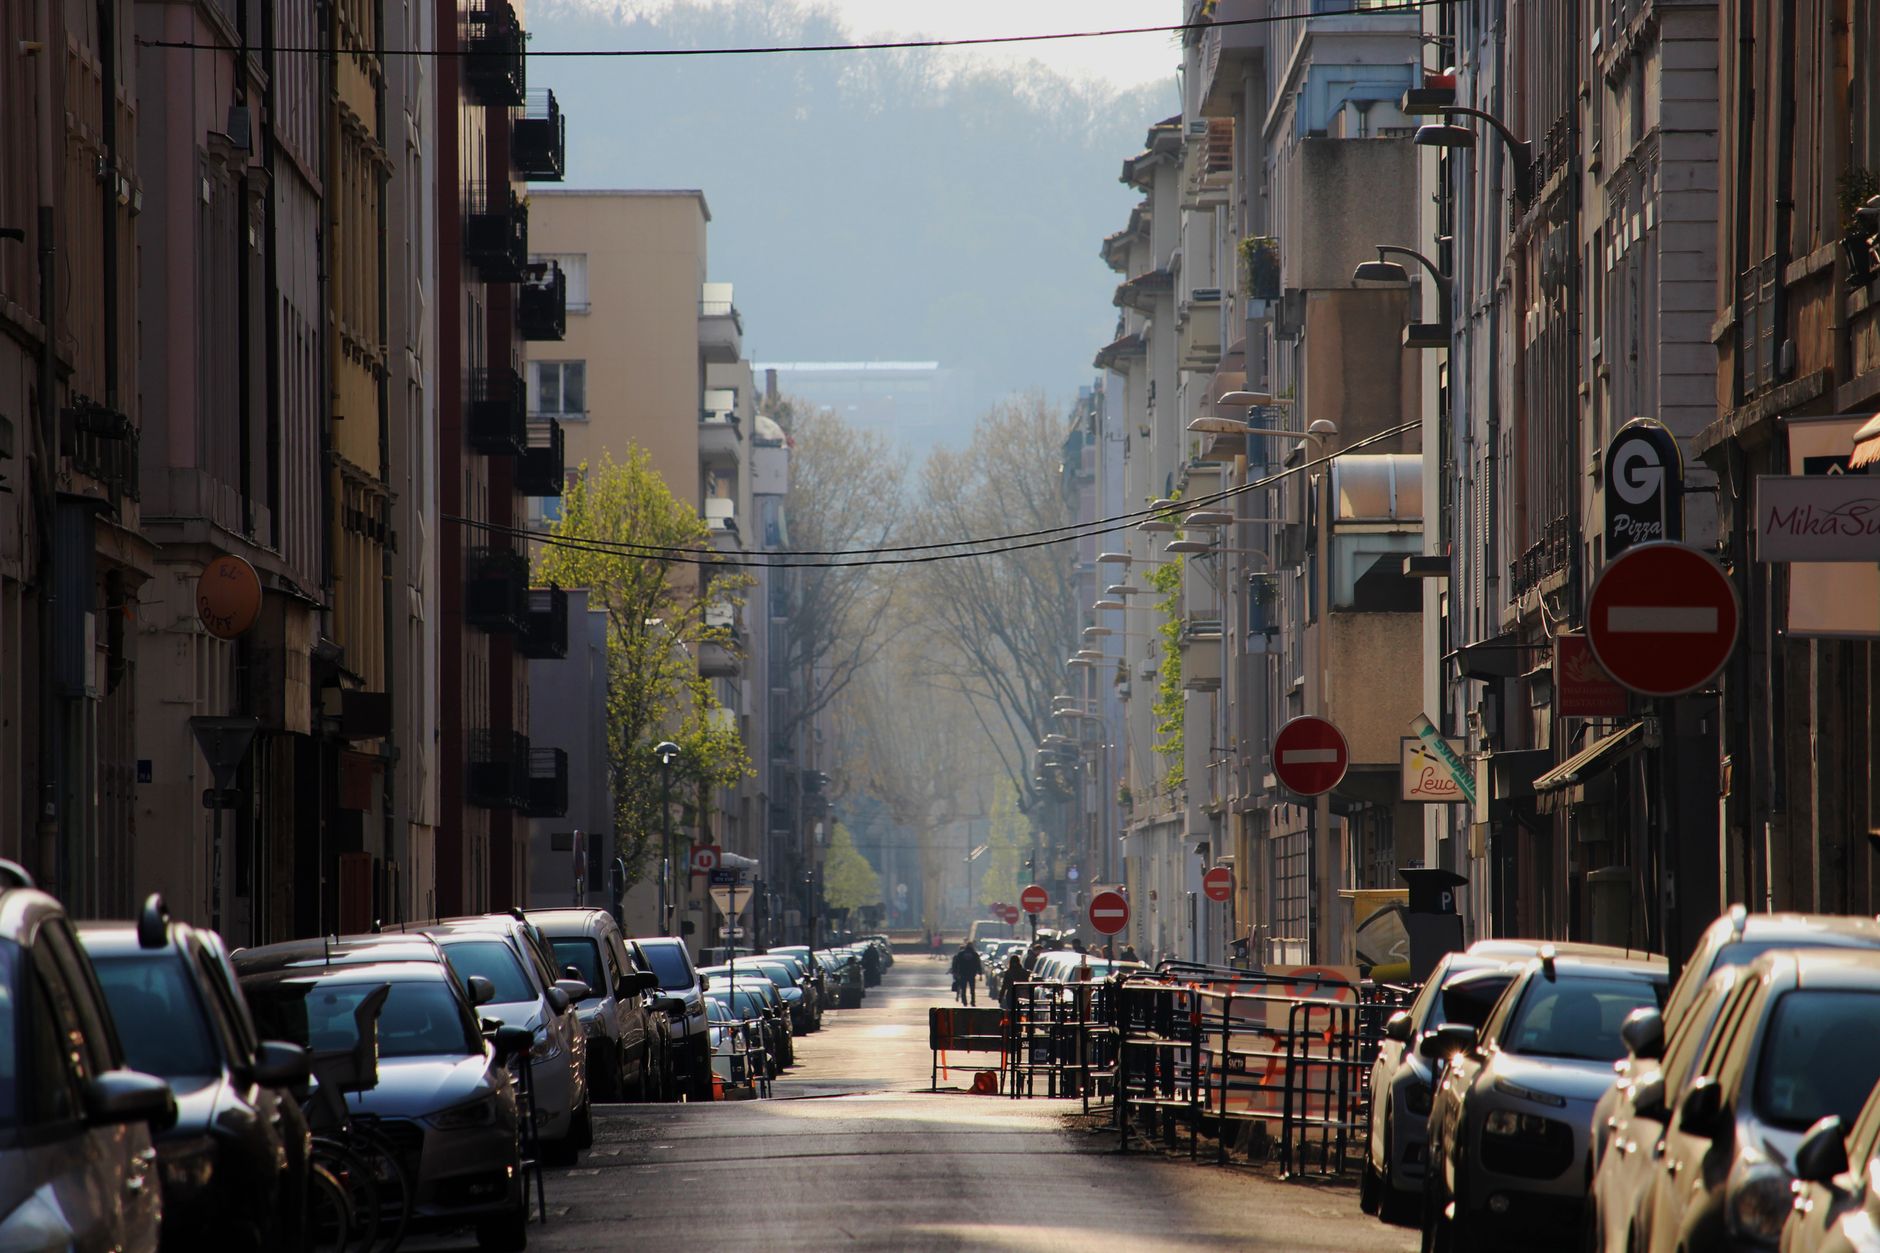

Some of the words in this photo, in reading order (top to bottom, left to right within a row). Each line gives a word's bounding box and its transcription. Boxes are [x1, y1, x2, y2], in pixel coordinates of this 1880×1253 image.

[1613, 439, 1665, 504] G
[1614, 514, 1662, 542] Pizza
[699, 856, 711, 867] U
[1441, 891, 1452, 911] P
